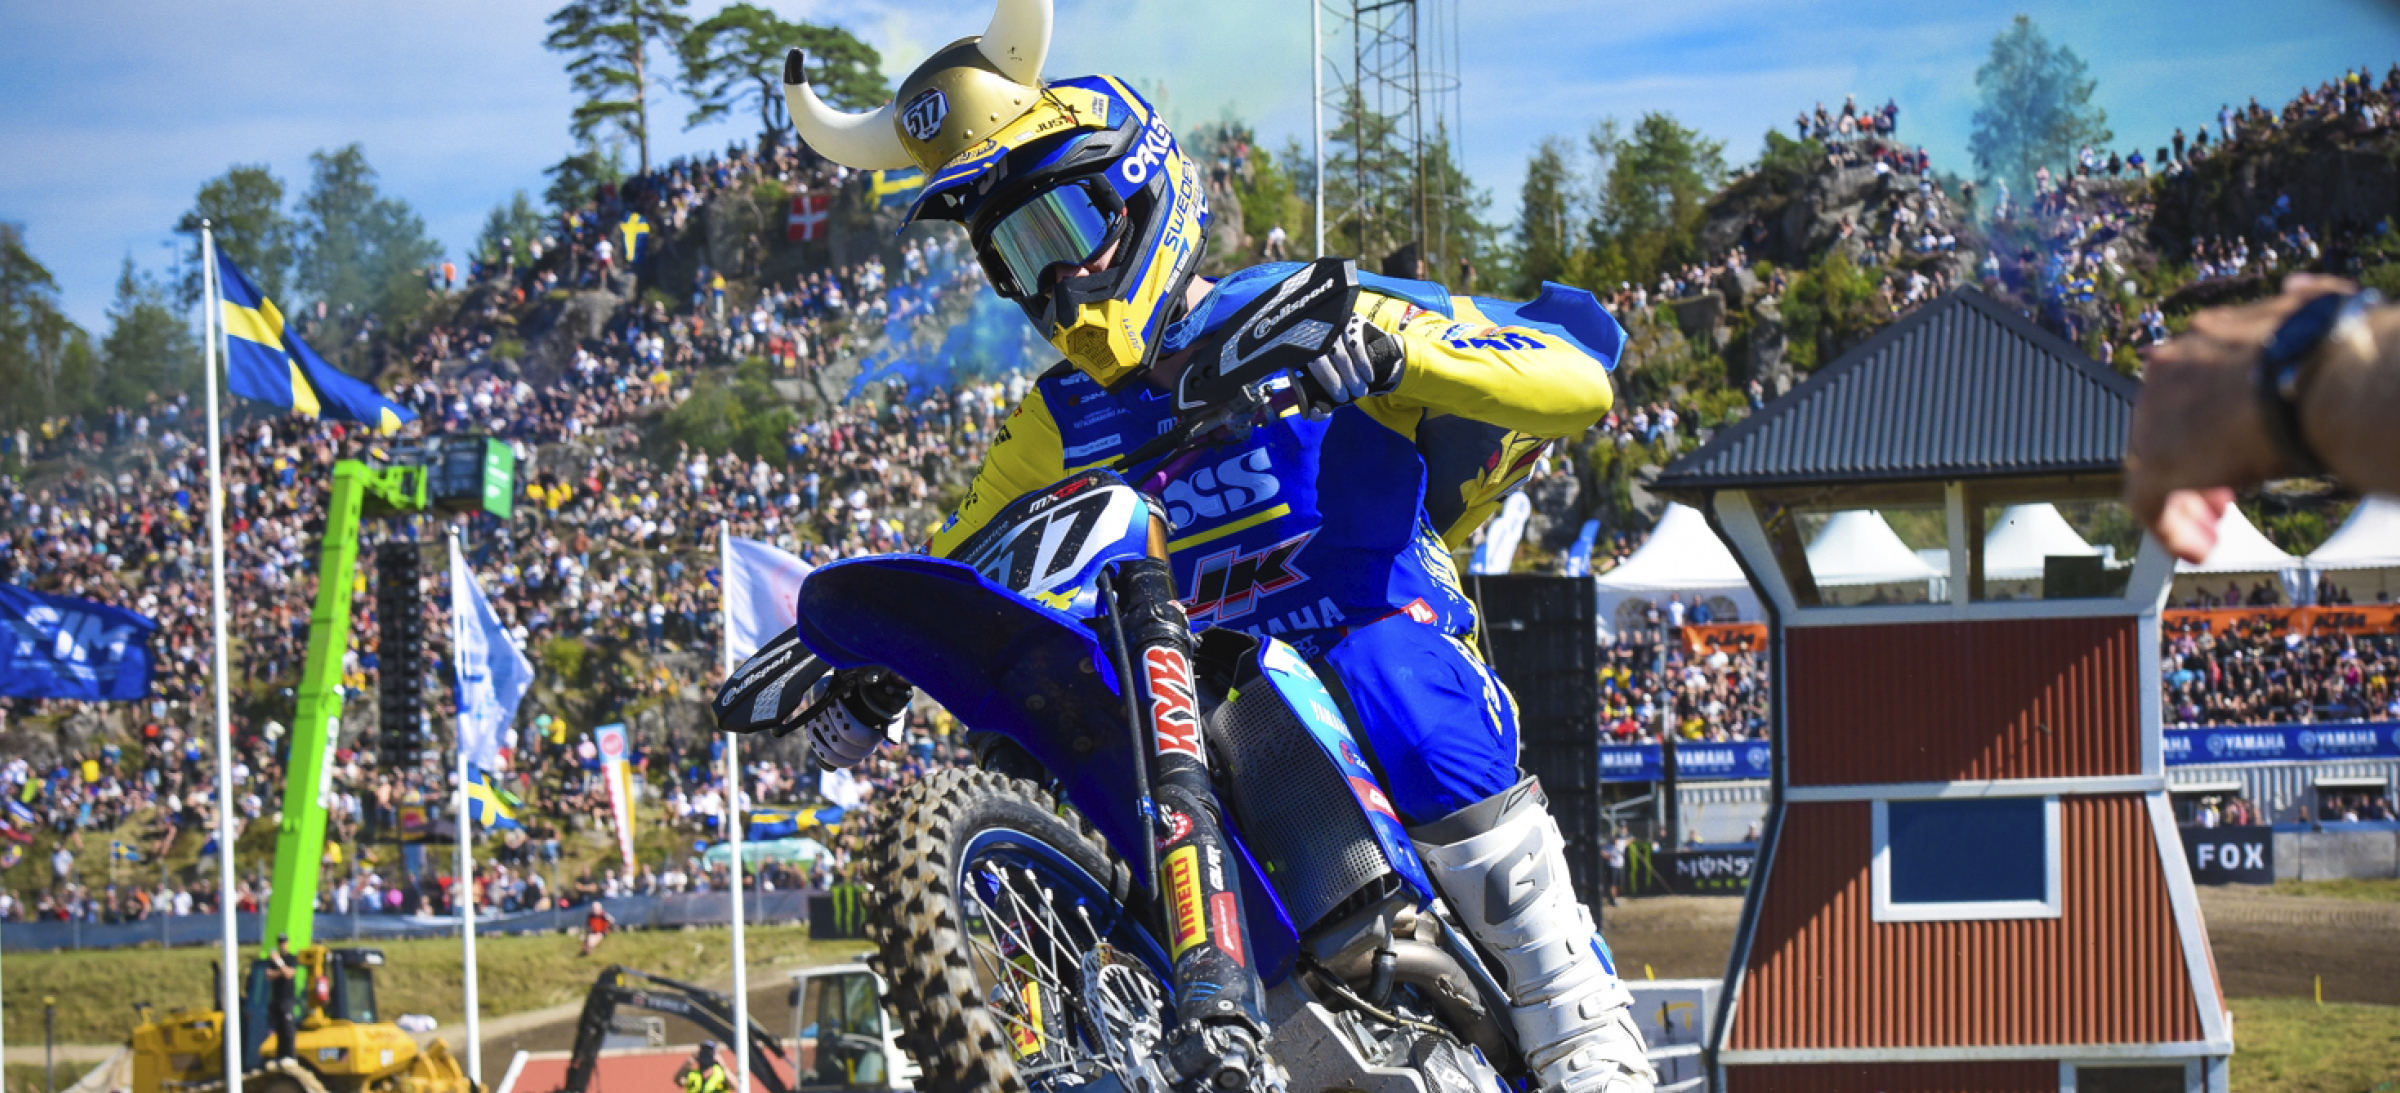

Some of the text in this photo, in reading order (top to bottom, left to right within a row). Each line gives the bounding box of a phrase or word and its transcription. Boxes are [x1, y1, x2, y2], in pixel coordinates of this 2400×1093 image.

[906, 94, 940, 137] 517
[1145, 646, 1201, 760] KYB
[2225, 732, 2286, 750] YAMAHA
[2317, 729, 2378, 748] YAMAHA
[2197, 844, 2264, 870] FOX
[1165, 855, 1197, 948] PIRELLI
